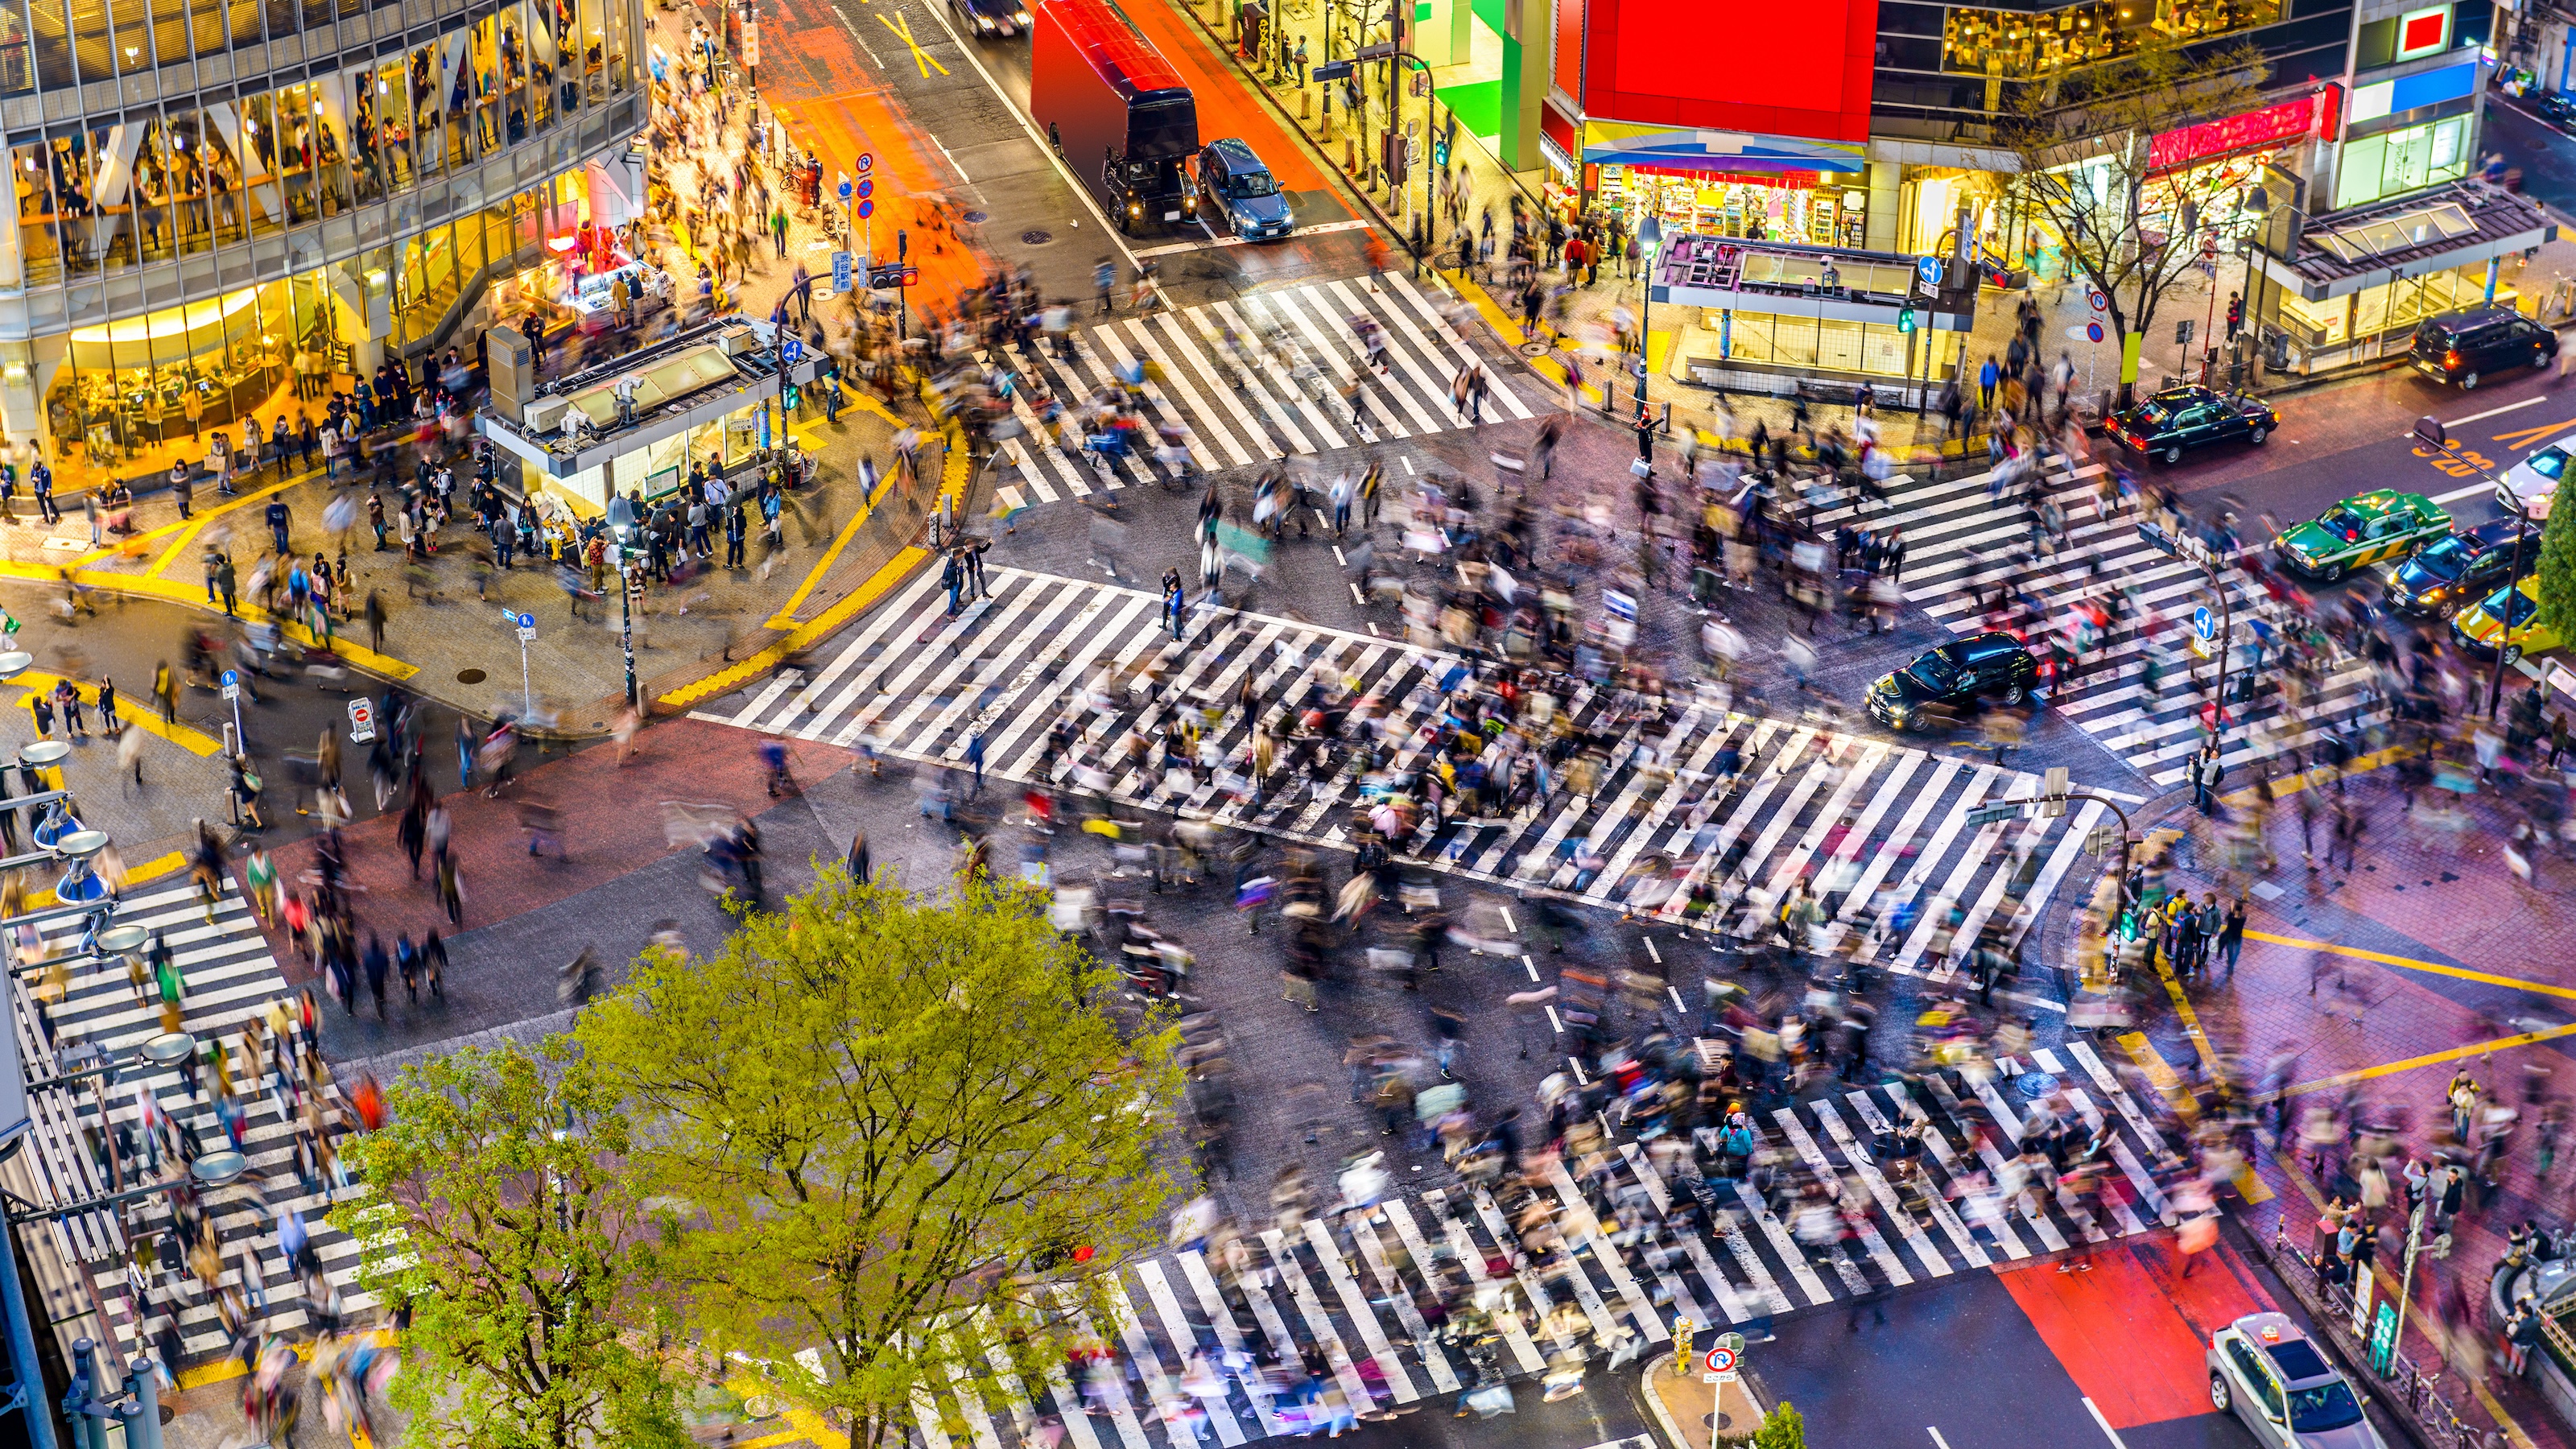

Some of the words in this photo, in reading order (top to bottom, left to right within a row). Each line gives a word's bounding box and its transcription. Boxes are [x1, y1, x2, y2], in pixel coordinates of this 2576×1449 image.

[2391, 145, 2403, 184] PROMISE
[840, 254, 849, 289] 渋谷駅前
